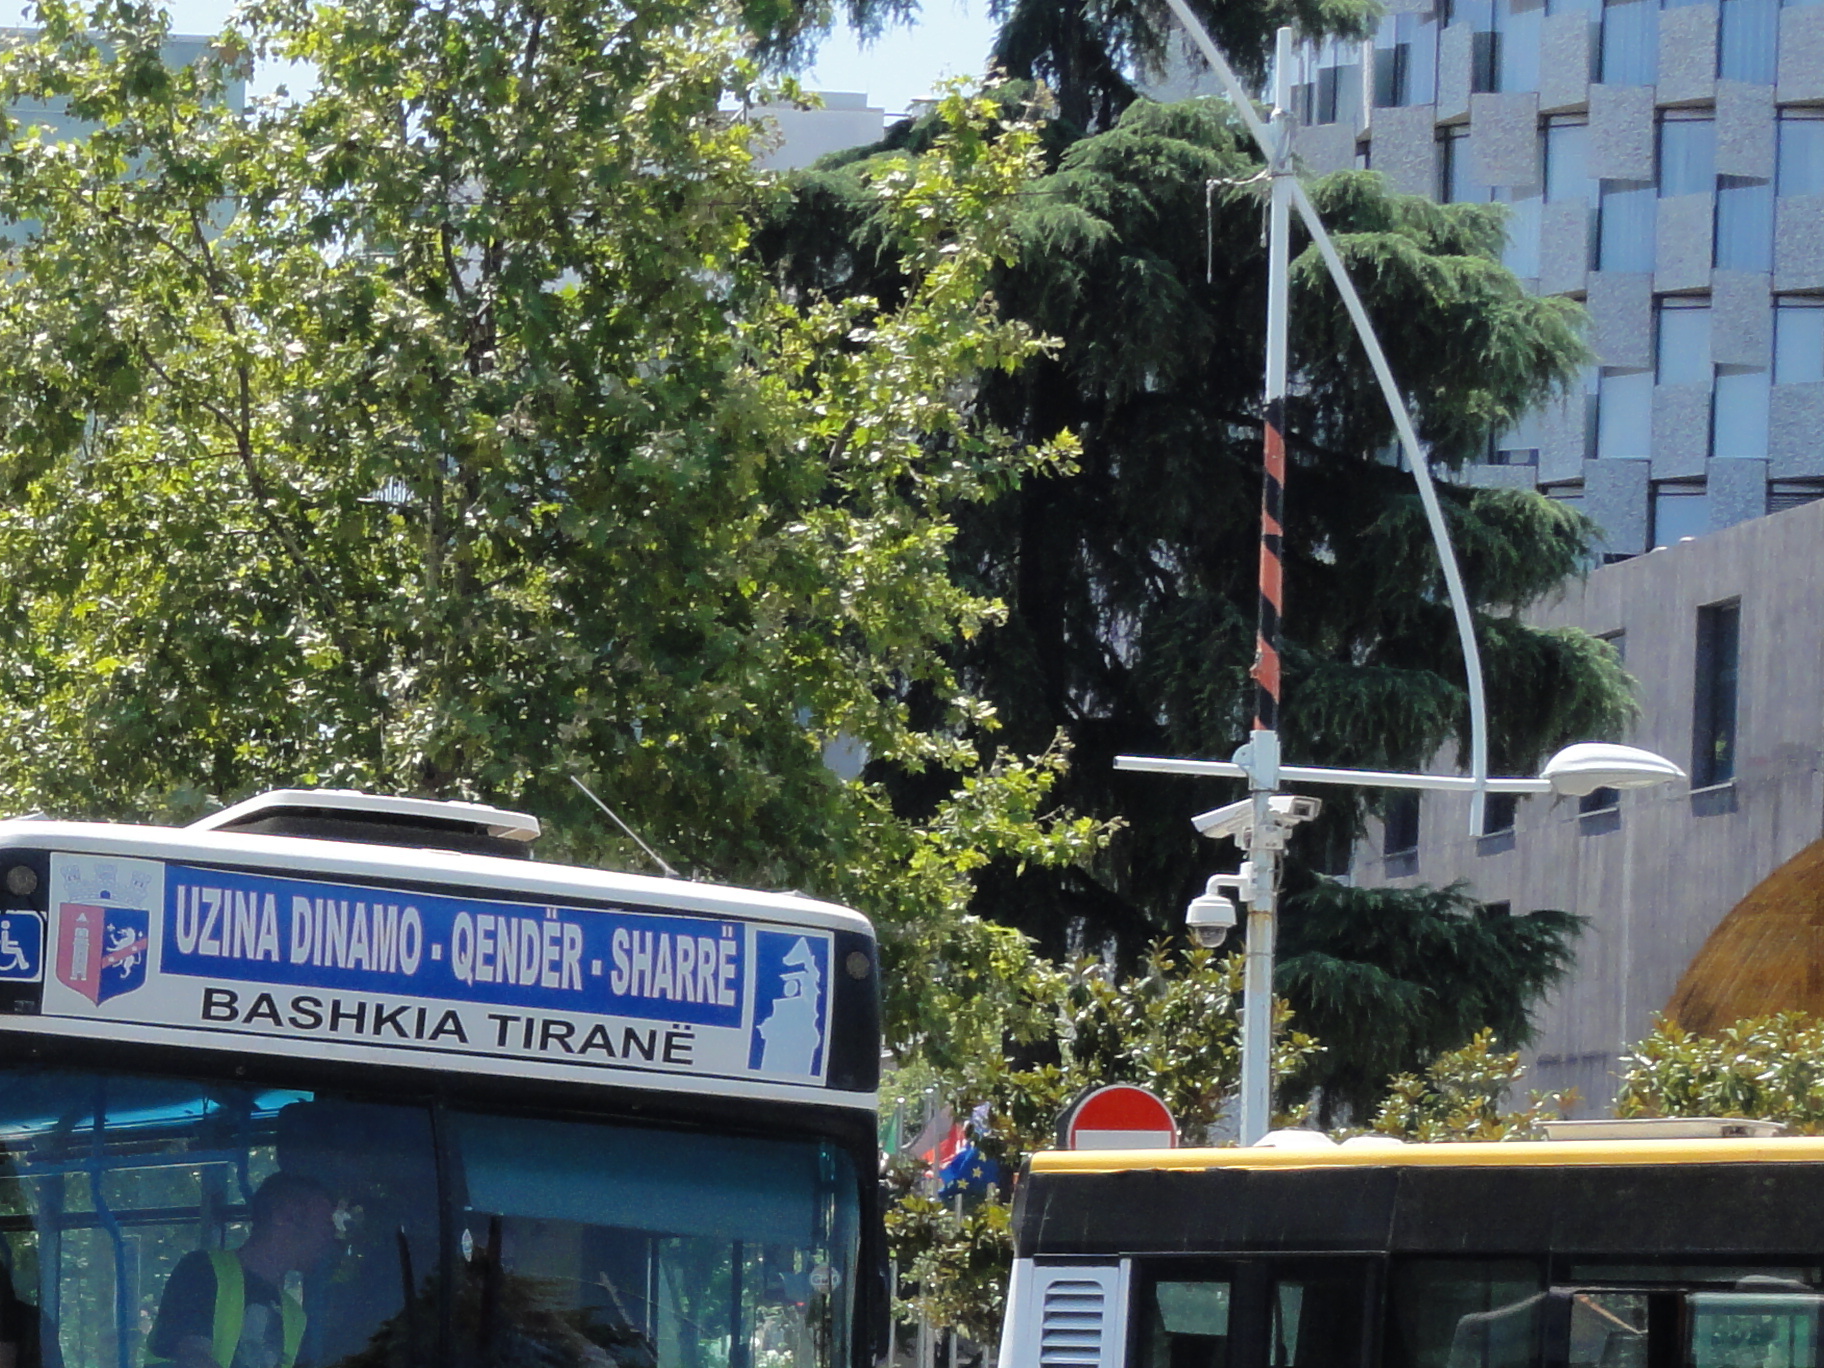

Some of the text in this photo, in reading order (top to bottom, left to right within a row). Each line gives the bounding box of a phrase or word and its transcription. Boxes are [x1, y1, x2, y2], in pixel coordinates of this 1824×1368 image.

[176, 885, 280, 962] UZINA
[290, 896, 423, 975] DINAMO
[451, 907, 584, 991] QENDËR
[610, 924, 737, 1007] SHARRË
[201, 987, 696, 1066] BASHKIA TIRANË
